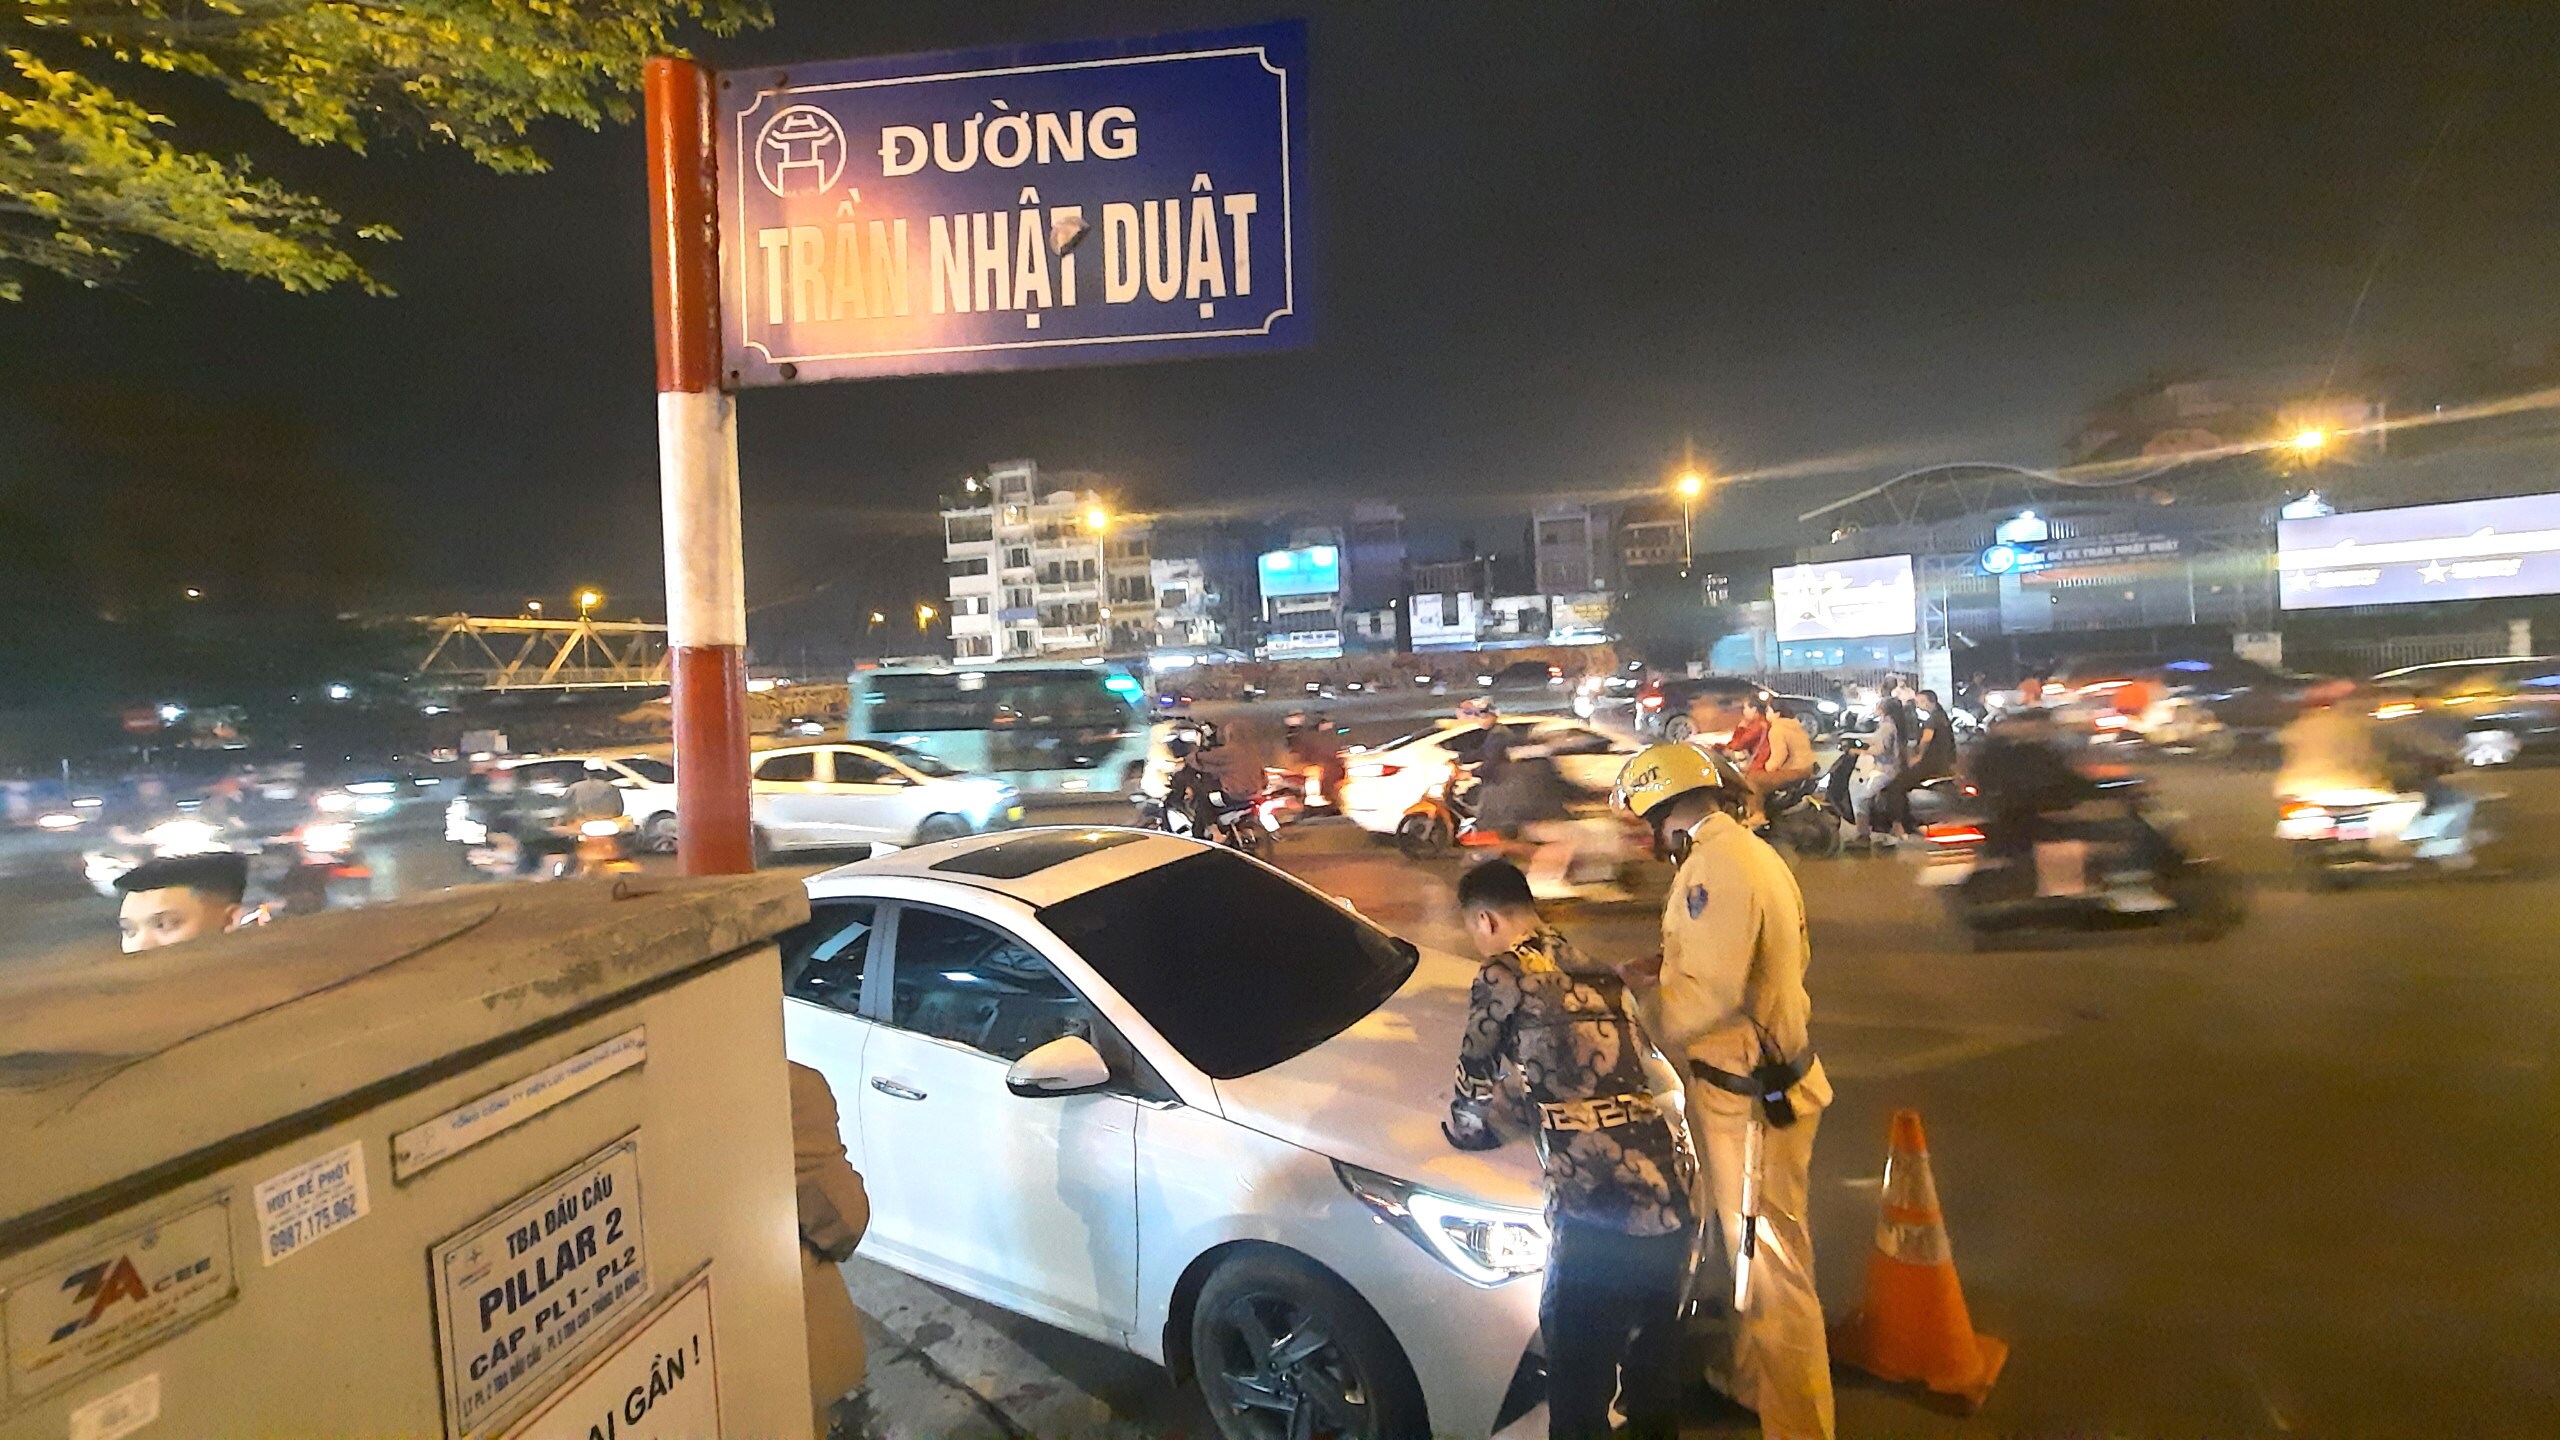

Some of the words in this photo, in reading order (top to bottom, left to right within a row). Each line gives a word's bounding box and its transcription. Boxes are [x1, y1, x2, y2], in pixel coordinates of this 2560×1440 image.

[878, 99, 1139, 177] ĐƯỜNG
[759, 187, 909, 325] TRẦN
[928, 186, 1083, 328] NHẬT
[1102, 173, 1257, 318] DUẬT
[479, 1225, 597, 1333] PILLAR
[605, 1207, 624, 1245] 2
[506, 1219, 541, 1260] TBA
[470, 1326, 526, 1381] CÁP
[596, 1246, 636, 1288] PL2
[624, 1347, 685, 1426] GẦN
